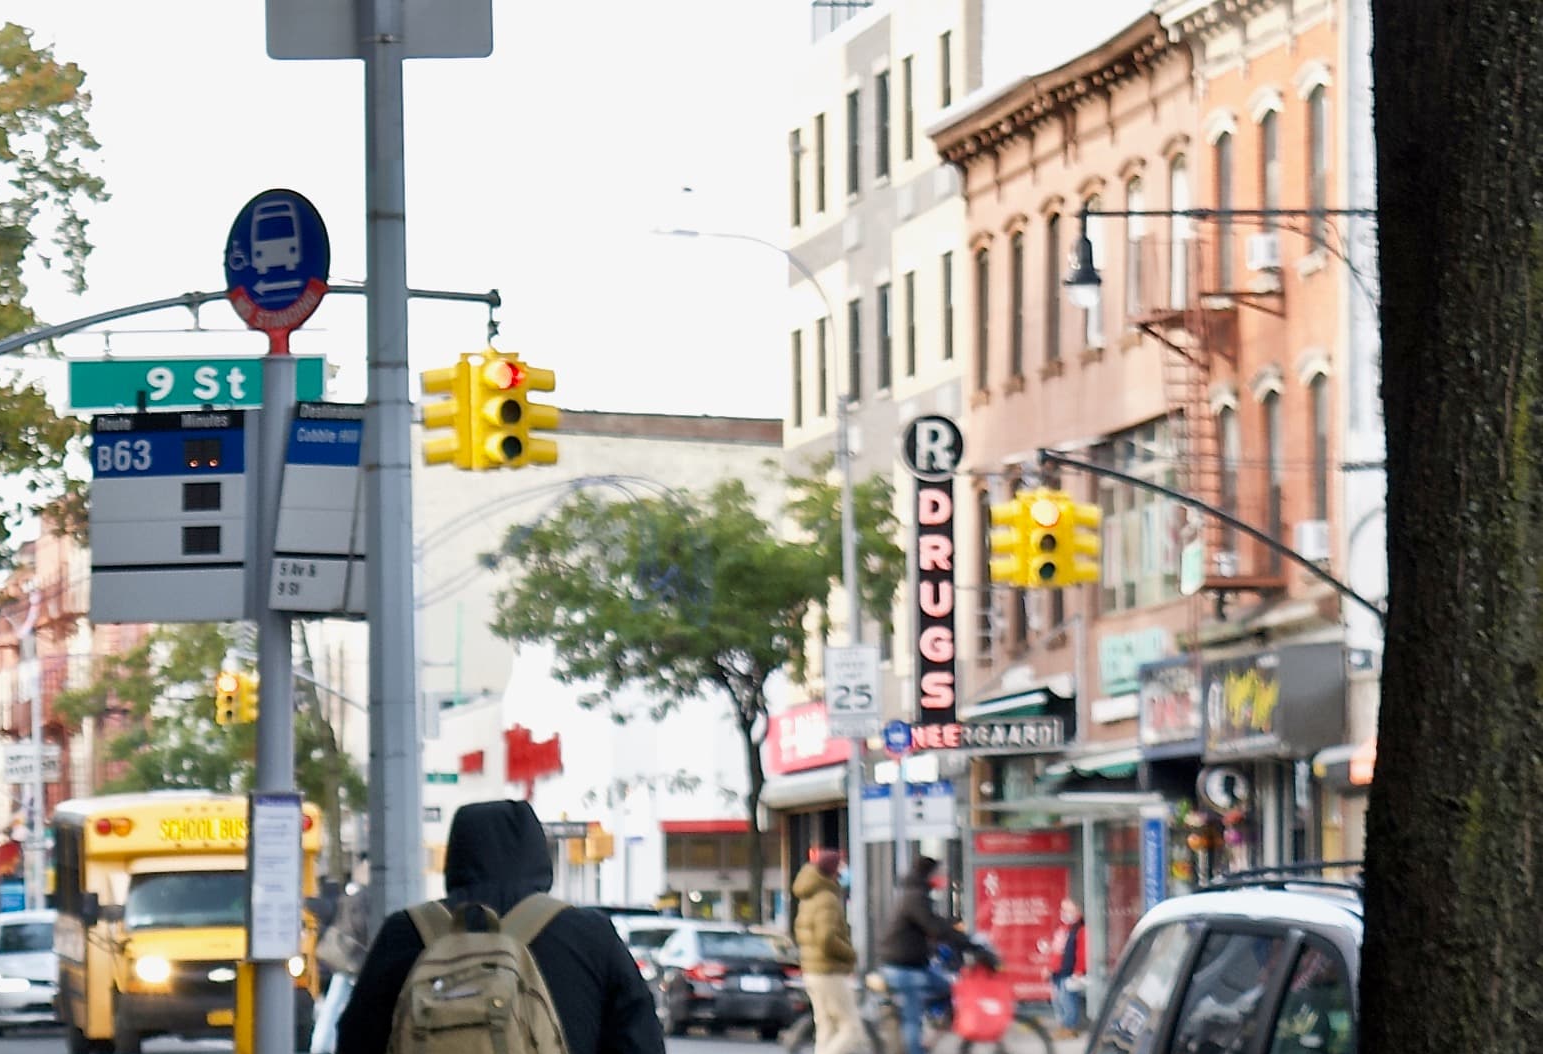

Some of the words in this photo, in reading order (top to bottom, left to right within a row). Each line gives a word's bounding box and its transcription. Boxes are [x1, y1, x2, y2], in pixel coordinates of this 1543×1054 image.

[146, 367, 174, 401] 9
[193, 367, 246, 400] St
[180, 414, 229, 428] Minutes
[97, 439, 152, 471] B63
[918, 488, 955, 709] DRUGS
[834, 684, 873, 710] 25
[160, 818, 216, 841] SCHOOL
[219, 818, 247, 840] BUS
